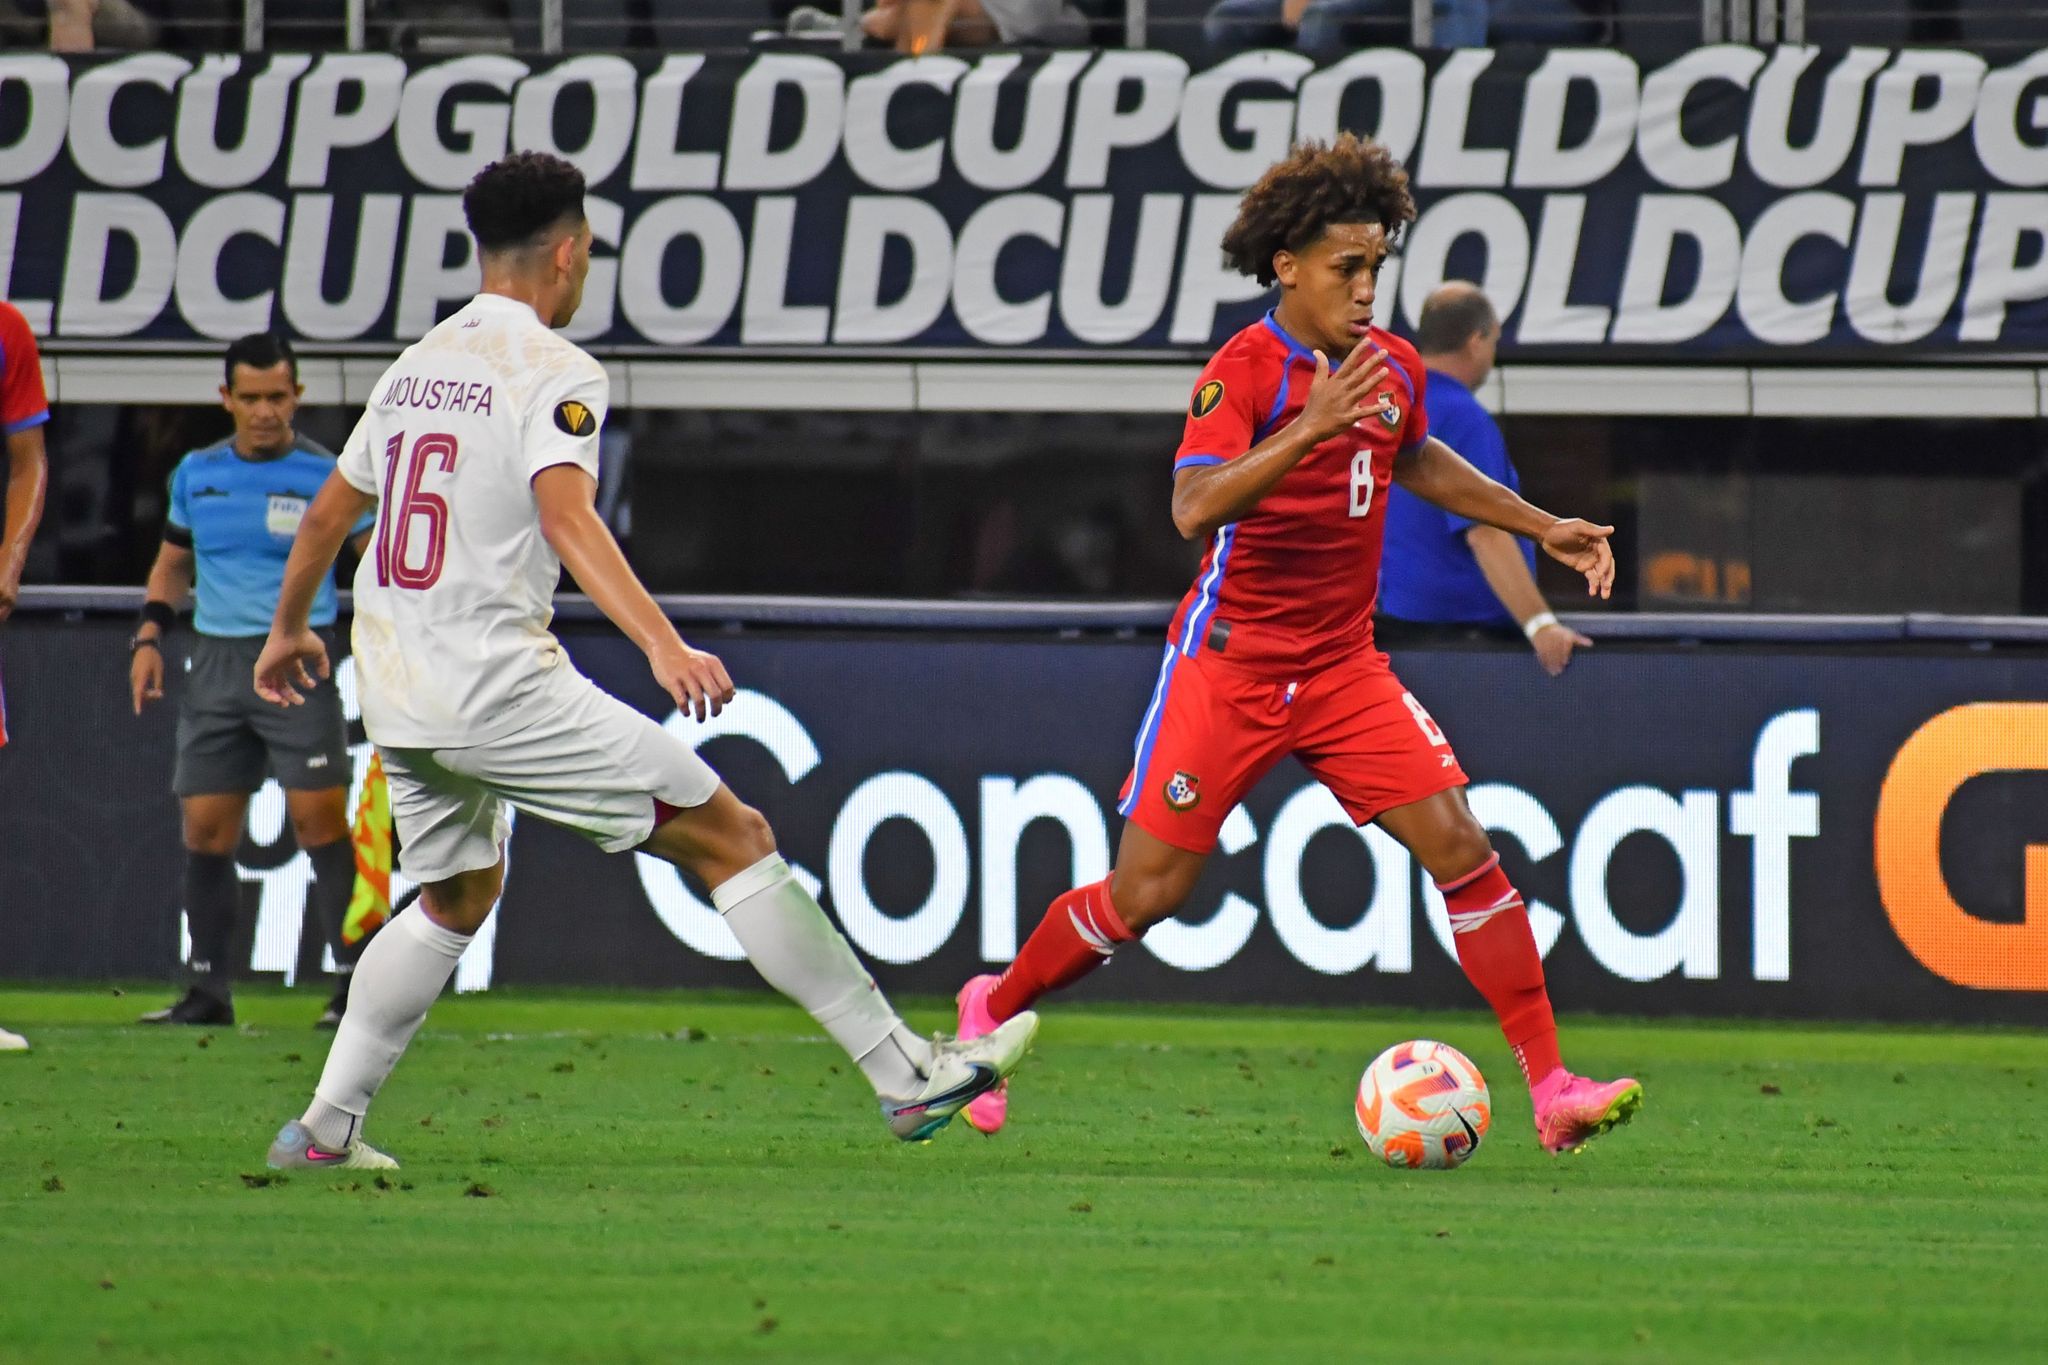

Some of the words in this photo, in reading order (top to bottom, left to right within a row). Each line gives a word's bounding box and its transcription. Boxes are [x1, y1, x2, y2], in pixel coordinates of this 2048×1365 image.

[380, 376, 493, 417] MOUSTAFA
[376, 430, 459, 591] 16
[1348, 449, 1375, 518] 8
[1402, 691, 1447, 748] 8
[634, 688, 1820, 982] Concacaf
